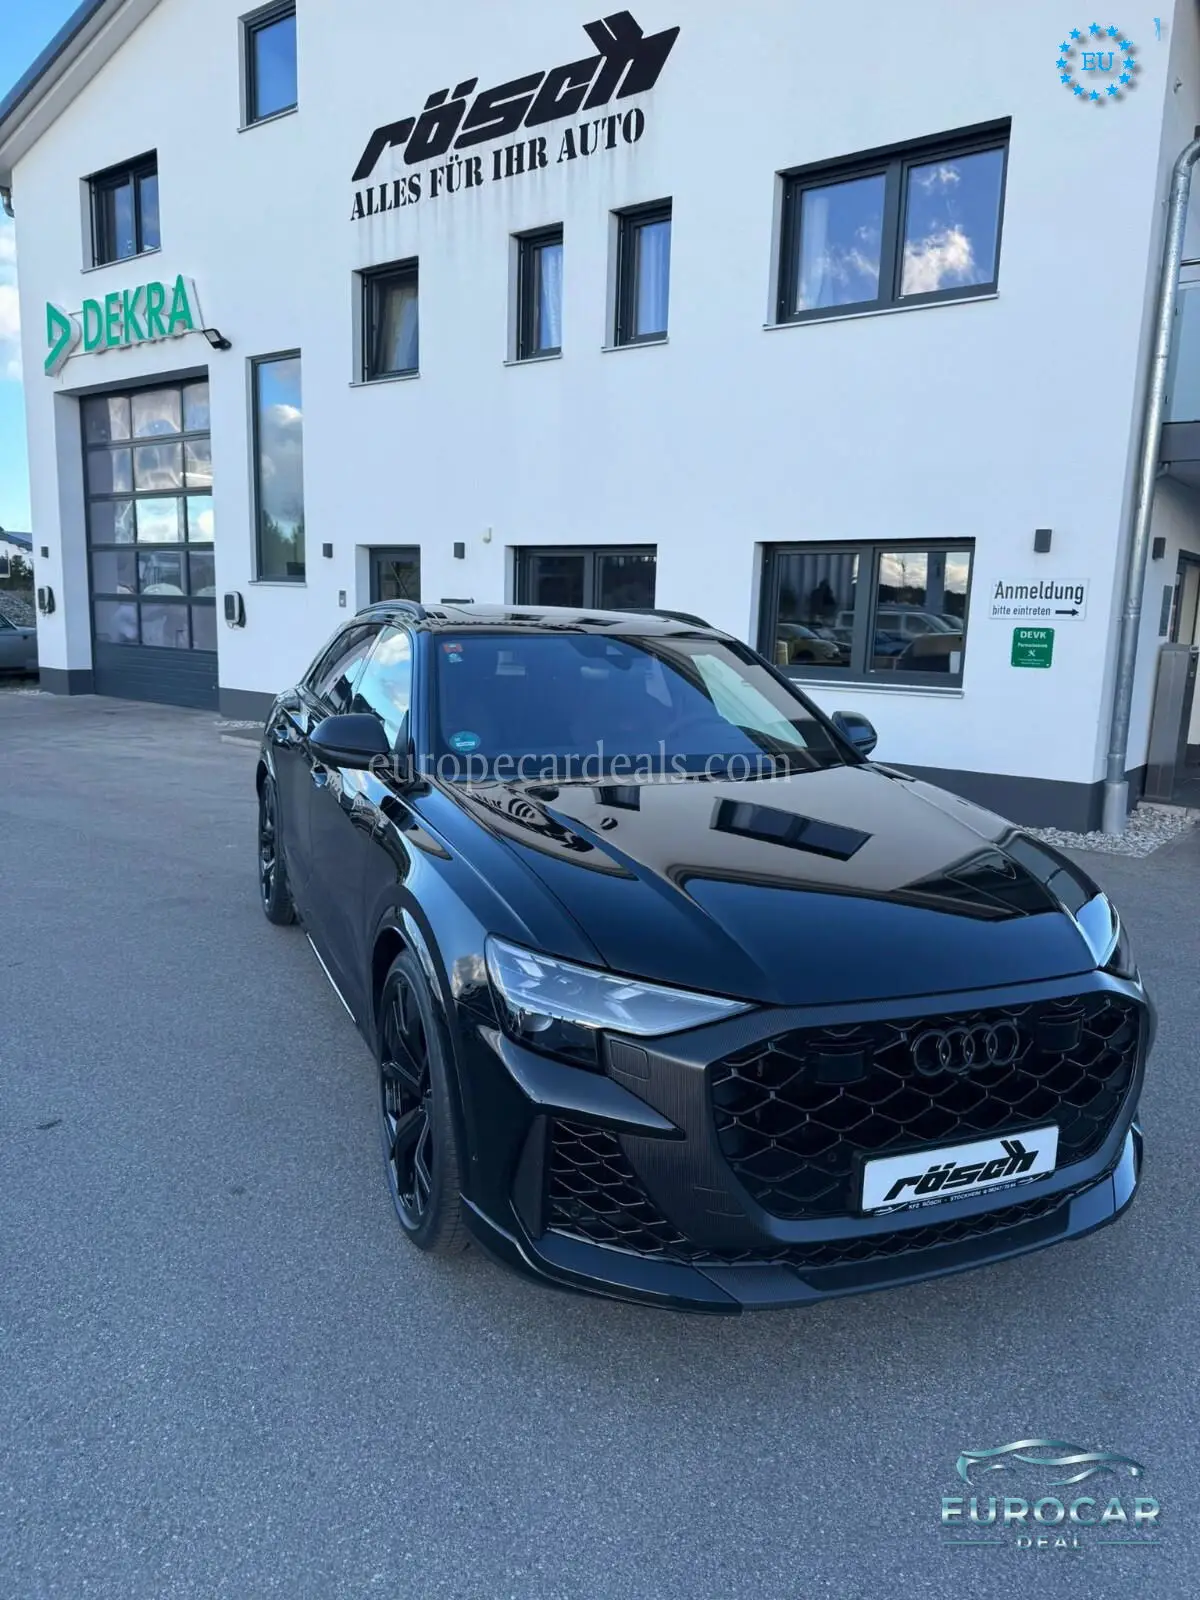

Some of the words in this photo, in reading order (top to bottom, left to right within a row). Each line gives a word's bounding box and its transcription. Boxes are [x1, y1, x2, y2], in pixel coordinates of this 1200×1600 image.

[350, 173, 422, 221] ALLES
[430, 155, 484, 198] FÜR
[492, 136, 549, 181] IHR
[556, 107, 645, 164] AUTO
[82, 274, 195, 353] DEKRA
[994, 580, 1085, 605] Anmeldung
[992, 605, 1011, 616] bitte
[1013, 606, 1051, 616] eintreten
[1020, 630, 1047, 639] DEVK
